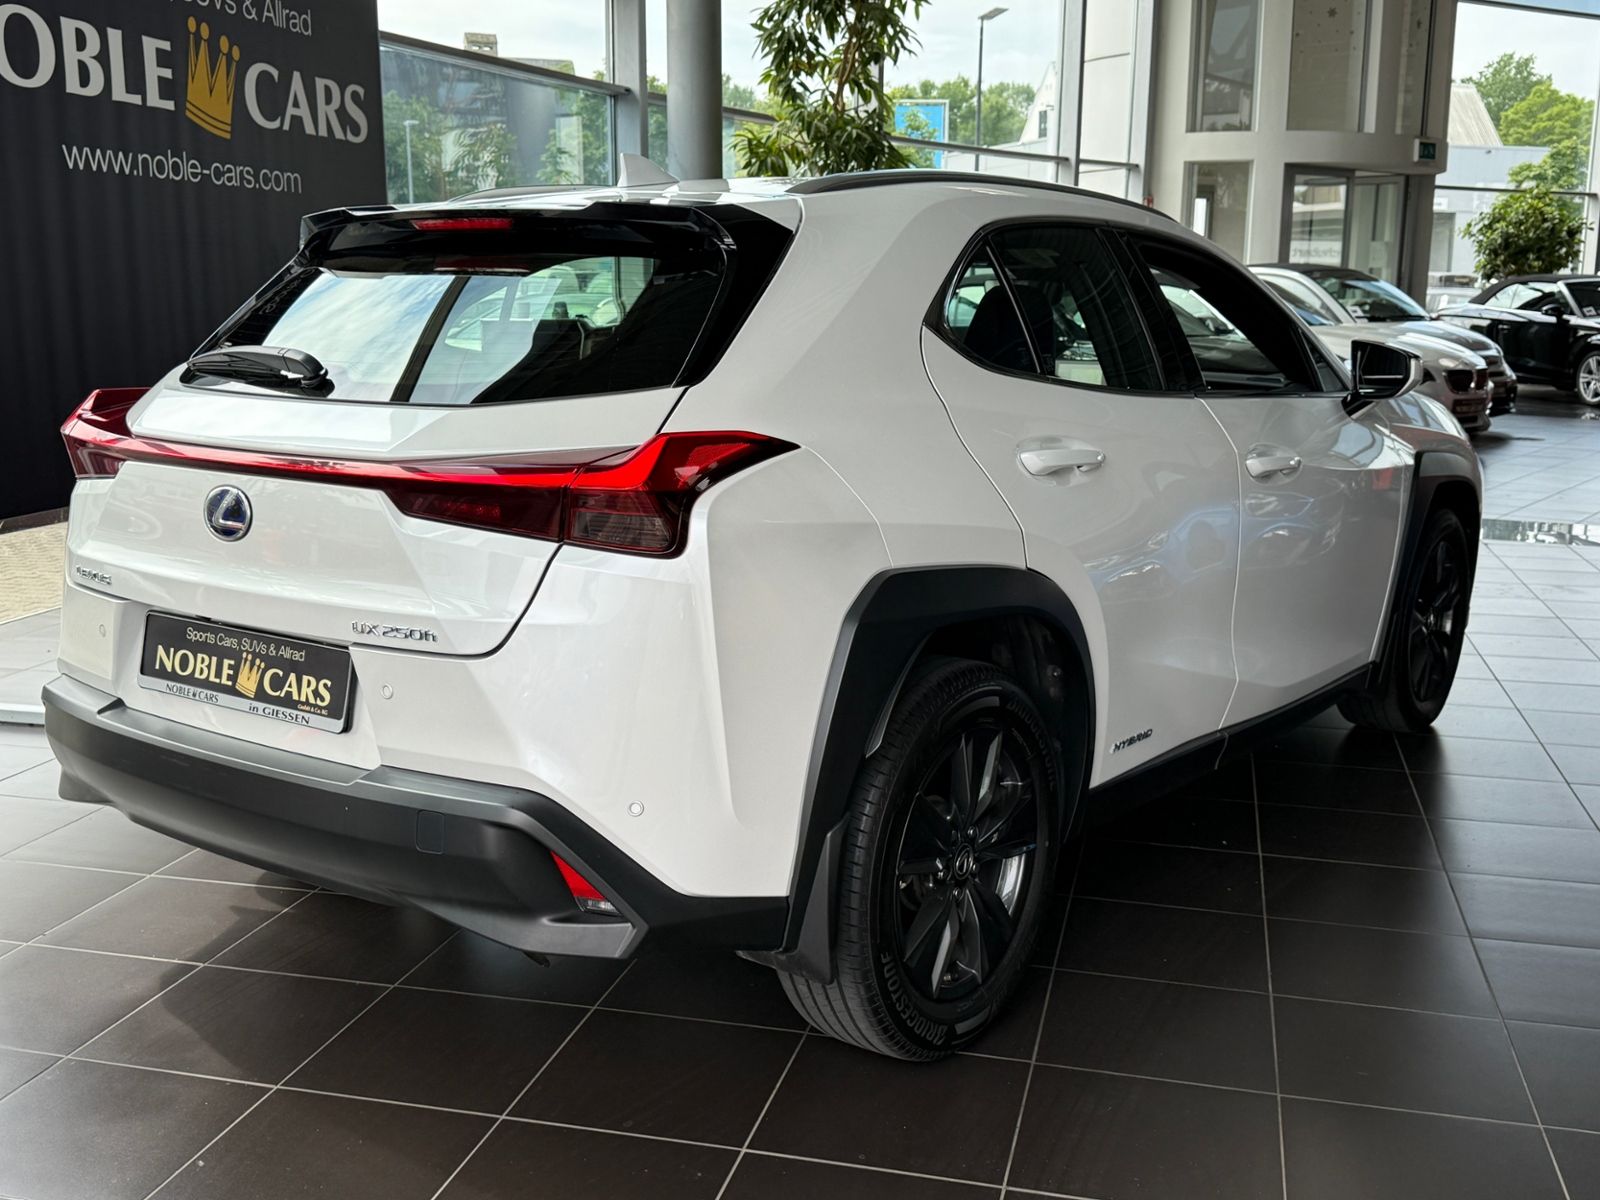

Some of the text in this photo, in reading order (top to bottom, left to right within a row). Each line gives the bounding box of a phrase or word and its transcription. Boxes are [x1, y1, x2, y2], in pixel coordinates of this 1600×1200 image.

[242, 0, 258, 21] &
[262, 0, 312, 37] Allrad
[244, 62, 368, 144] CARS
[62, 144, 302, 194] www.noble-cars.com
[186, 626, 306, 662] Sports Cars, SUVs & Allrad
[351, 620, 438, 642] UX 250h
[155, 644, 332, 707] NOBLE CARS
[166, 683, 219, 704] NOBLE CARS
[249, 703, 310, 725] in GIESSEN
[1109, 728, 1153, 755] HYBRID
[880, 951, 949, 1046] BRIDGESTONE
